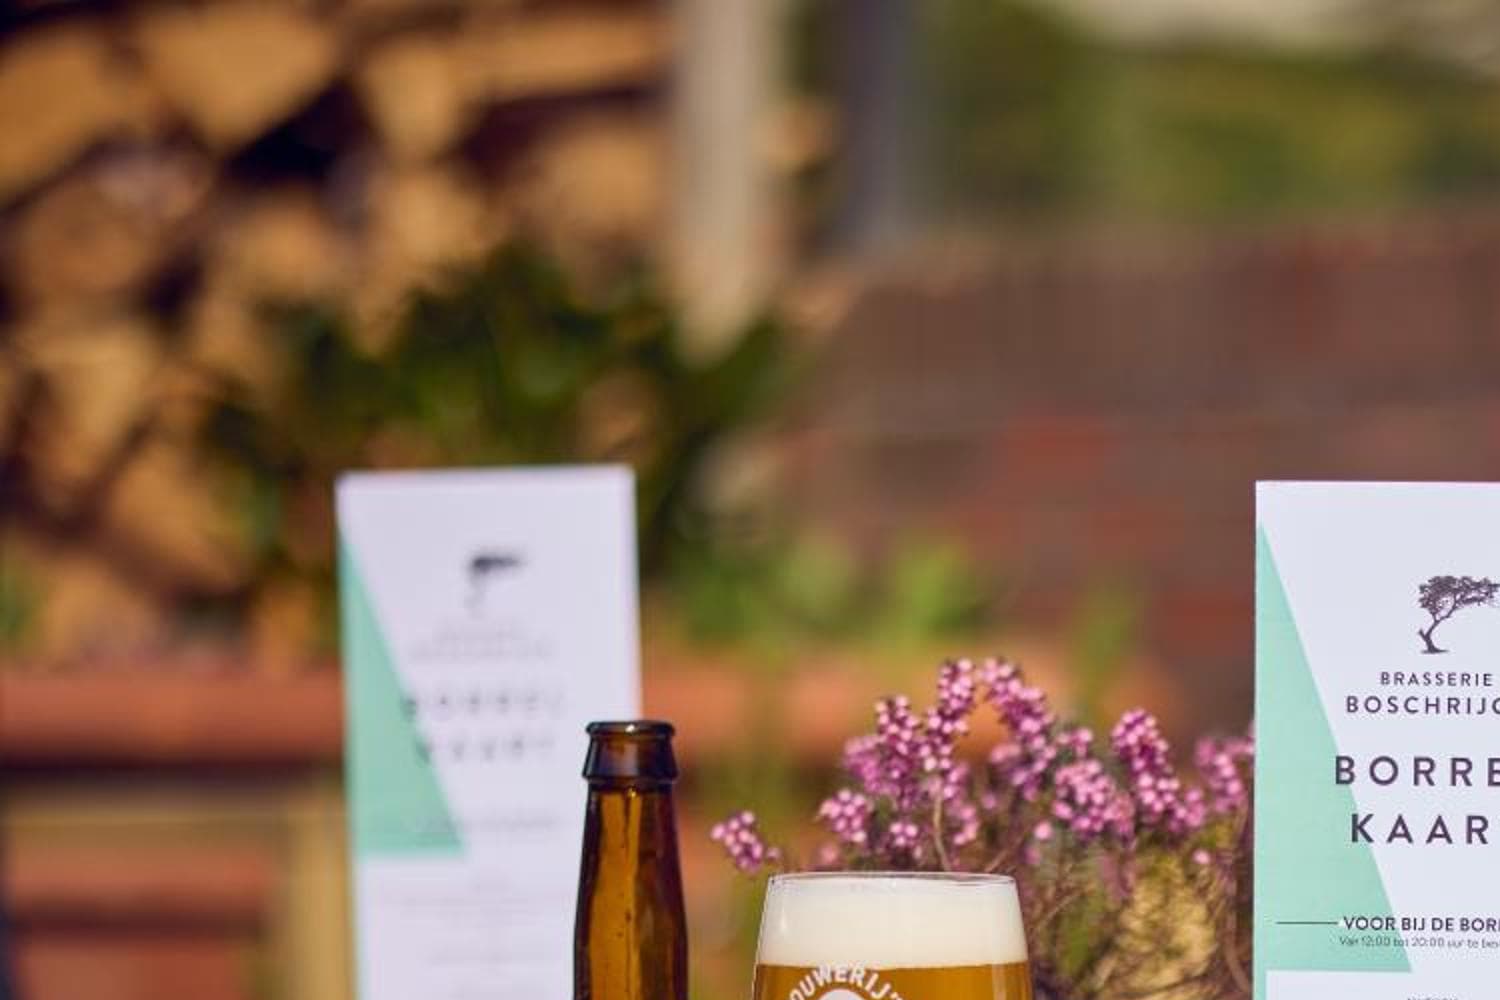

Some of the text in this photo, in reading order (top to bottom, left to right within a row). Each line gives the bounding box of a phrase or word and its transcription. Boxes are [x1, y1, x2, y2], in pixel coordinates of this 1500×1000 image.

[1380, 672, 1493, 687] BRASSERIE
[1343, 916, 1396, 931] VOOR
[1401, 916, 1425, 932] BIJ
[1431, 917, 1455, 932] DE
[1467, 937, 1478, 949] te
